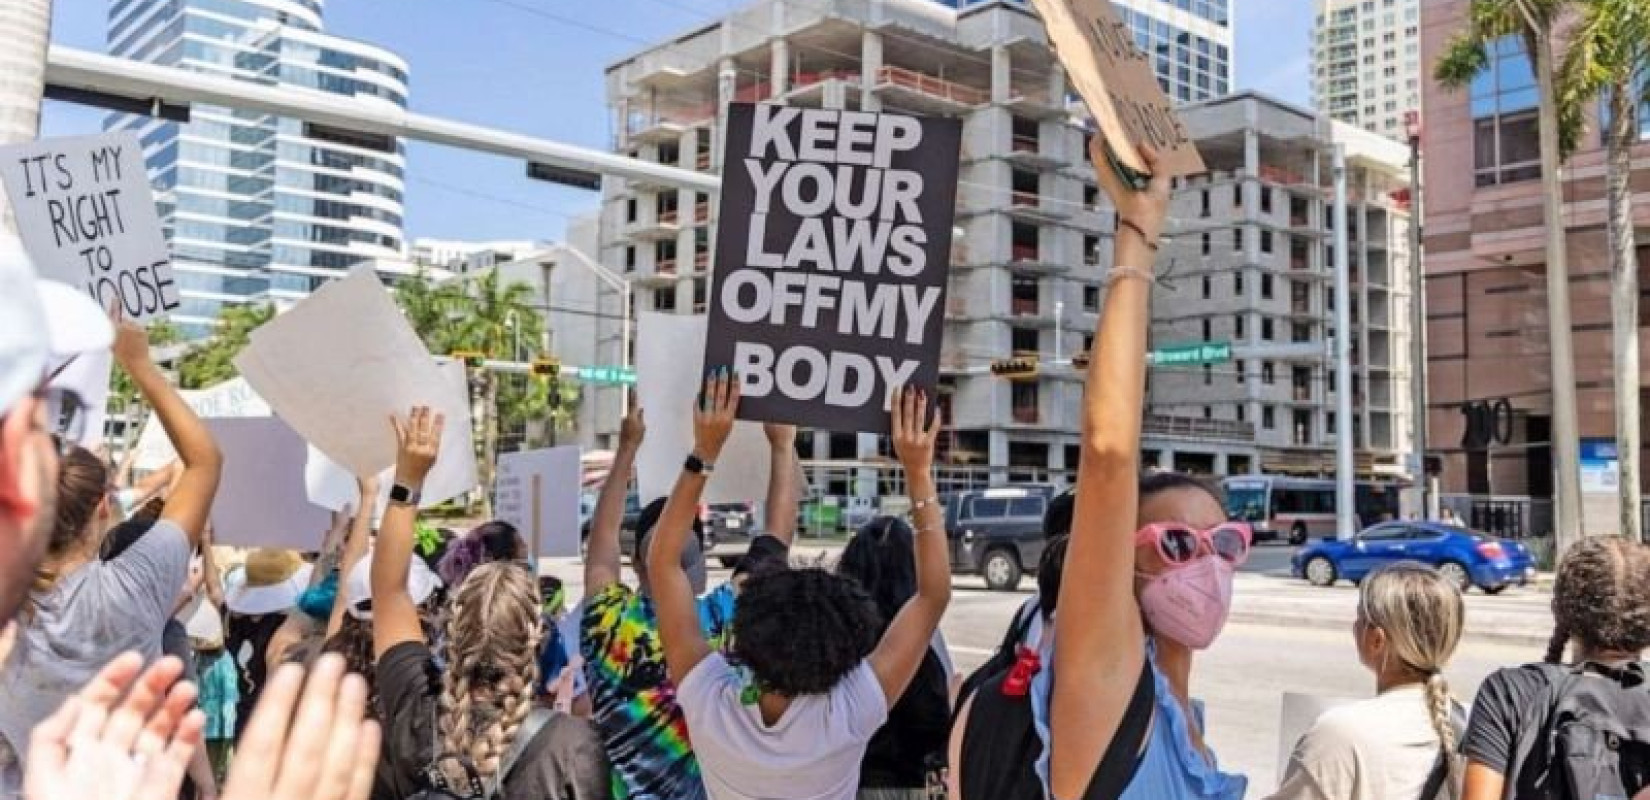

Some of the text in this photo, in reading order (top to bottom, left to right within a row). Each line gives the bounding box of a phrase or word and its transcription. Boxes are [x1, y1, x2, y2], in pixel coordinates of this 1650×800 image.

[91, 145, 122, 184] MY
[750, 104, 923, 168] KEEP
[47, 188, 125, 248] RIGHT
[744, 158, 924, 224] YOUR
[79, 245, 112, 277] TO
[746, 212, 928, 277] LAWS
[89, 259, 181, 322] OOSE
[733, 341, 921, 411] BODY
